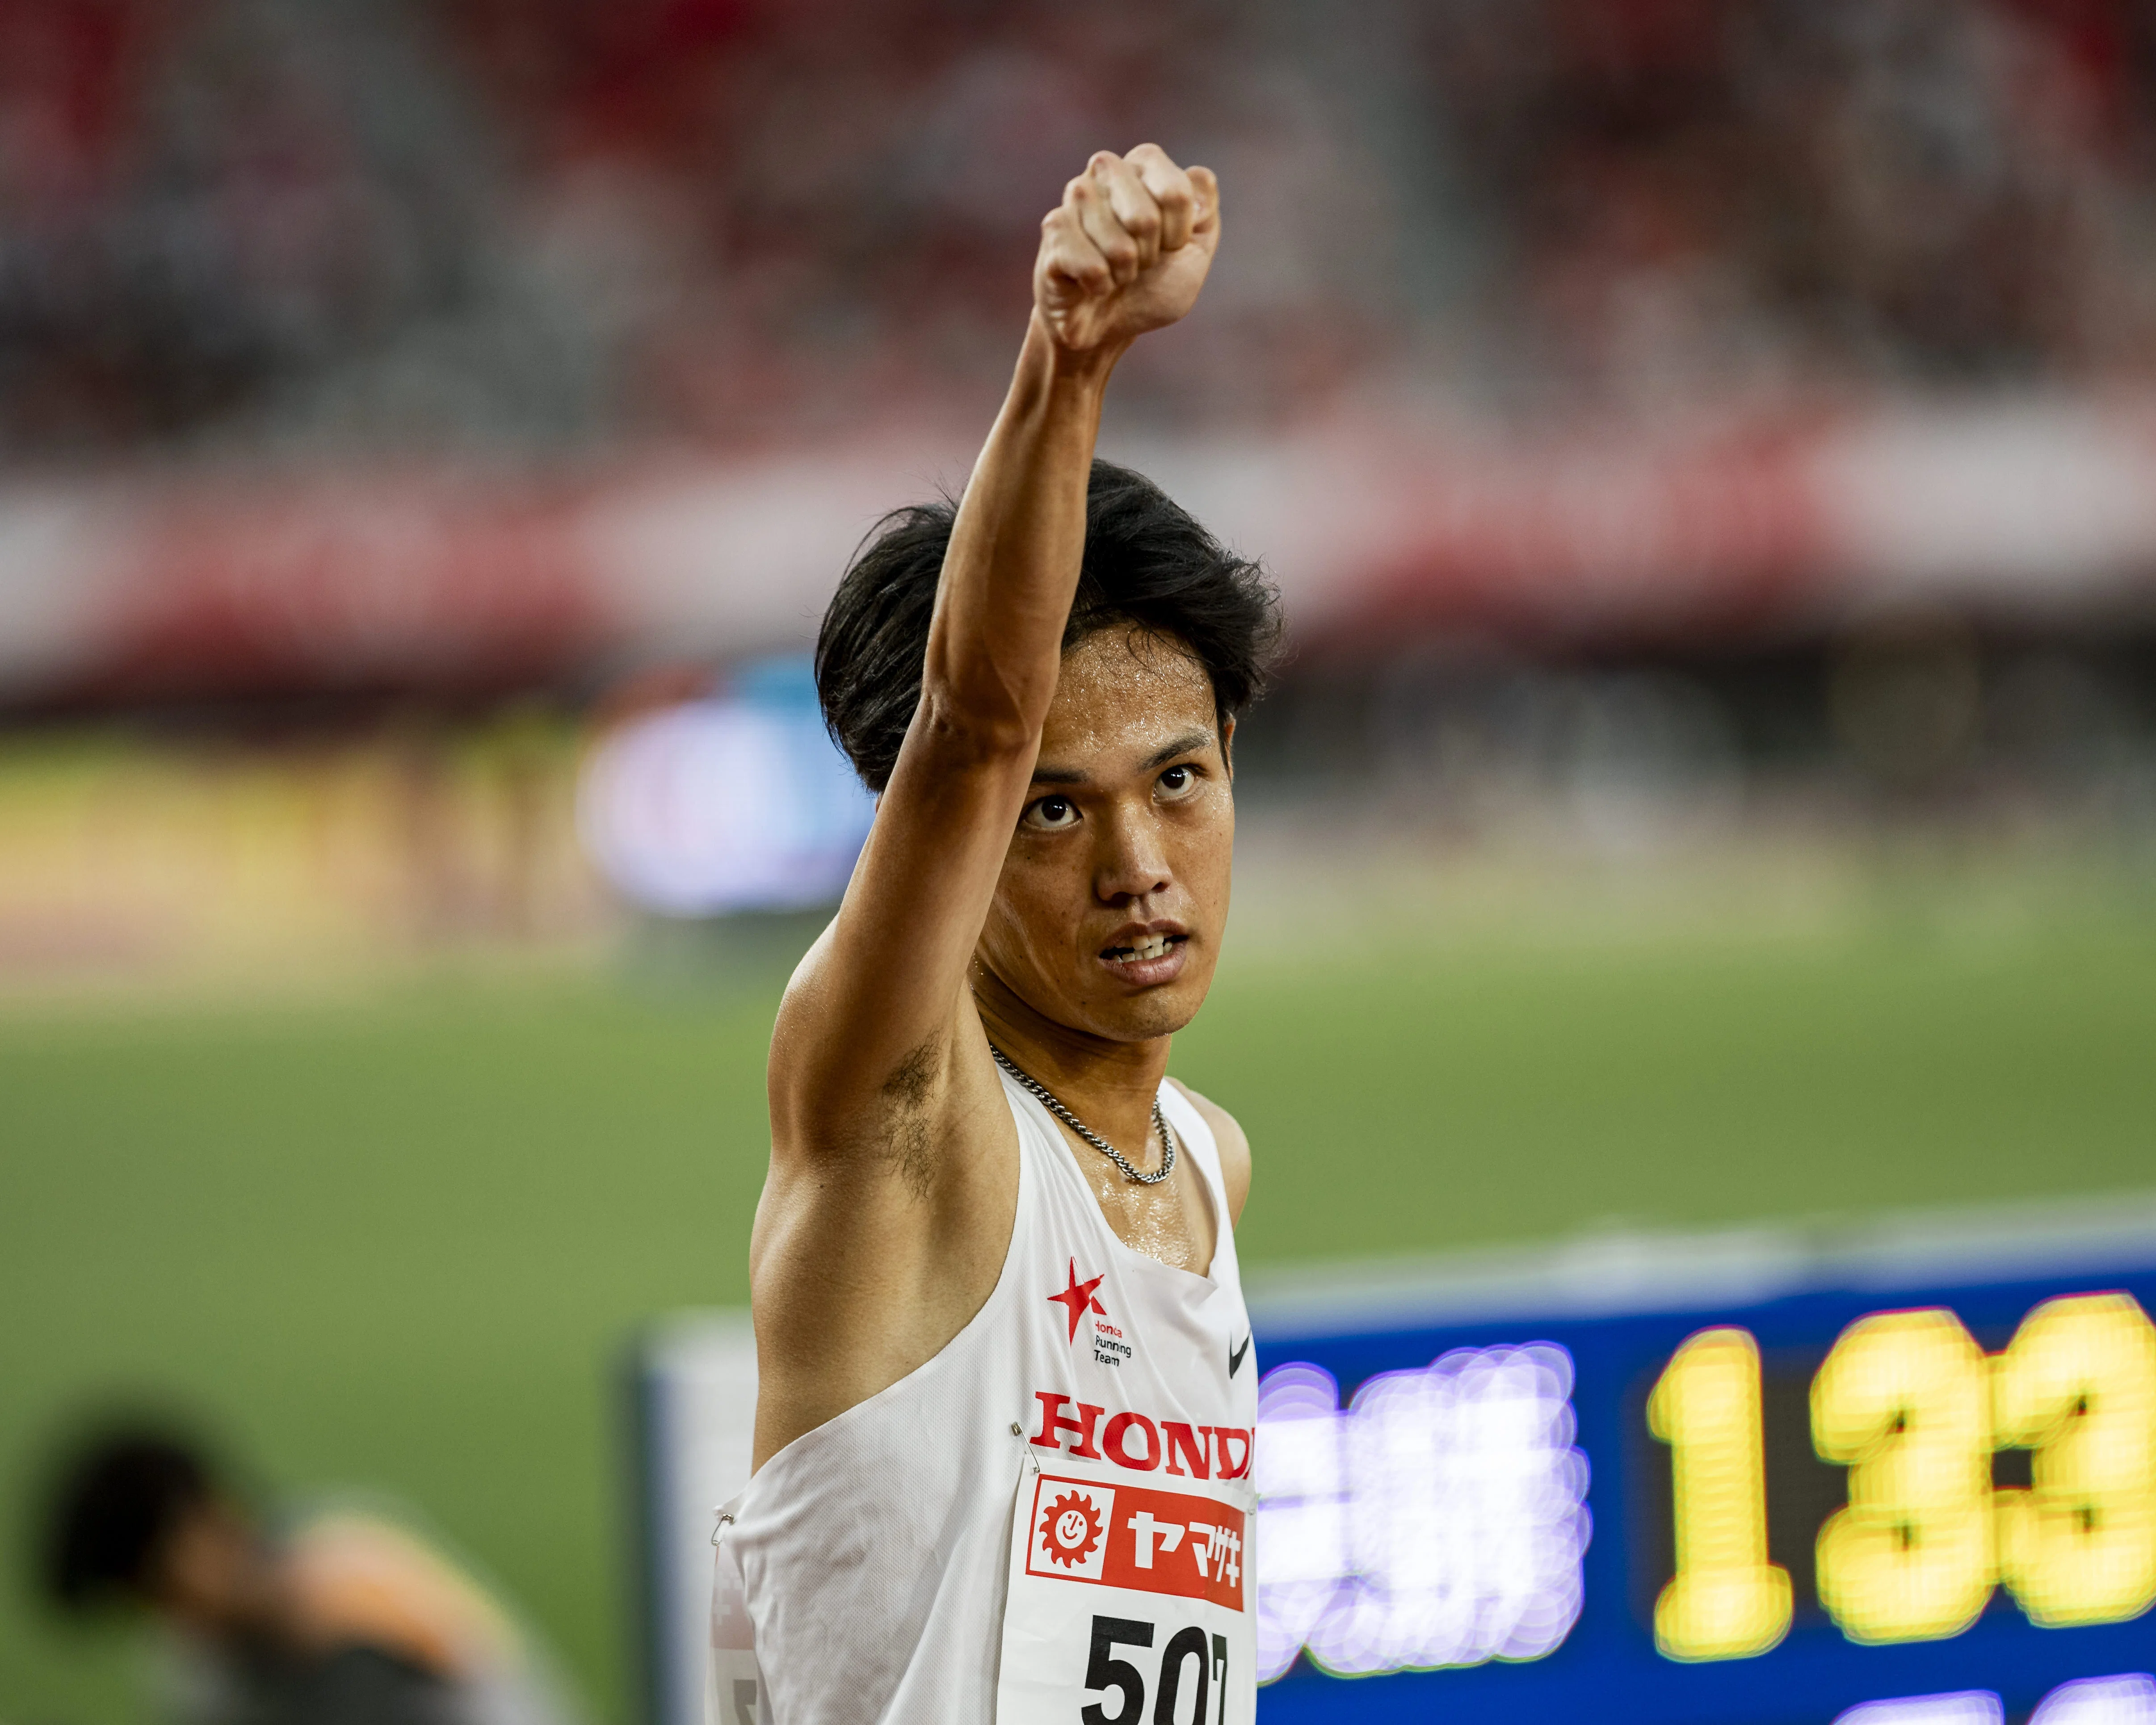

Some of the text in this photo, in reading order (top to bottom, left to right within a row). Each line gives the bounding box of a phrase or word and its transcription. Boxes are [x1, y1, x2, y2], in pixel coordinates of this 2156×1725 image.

[1094, 1349, 1120, 1367] Team
[1096, 1334, 1131, 1359] Running
[1030, 1391, 1255, 1480] HOND
[1080, 1614, 1228, 1725] 507
